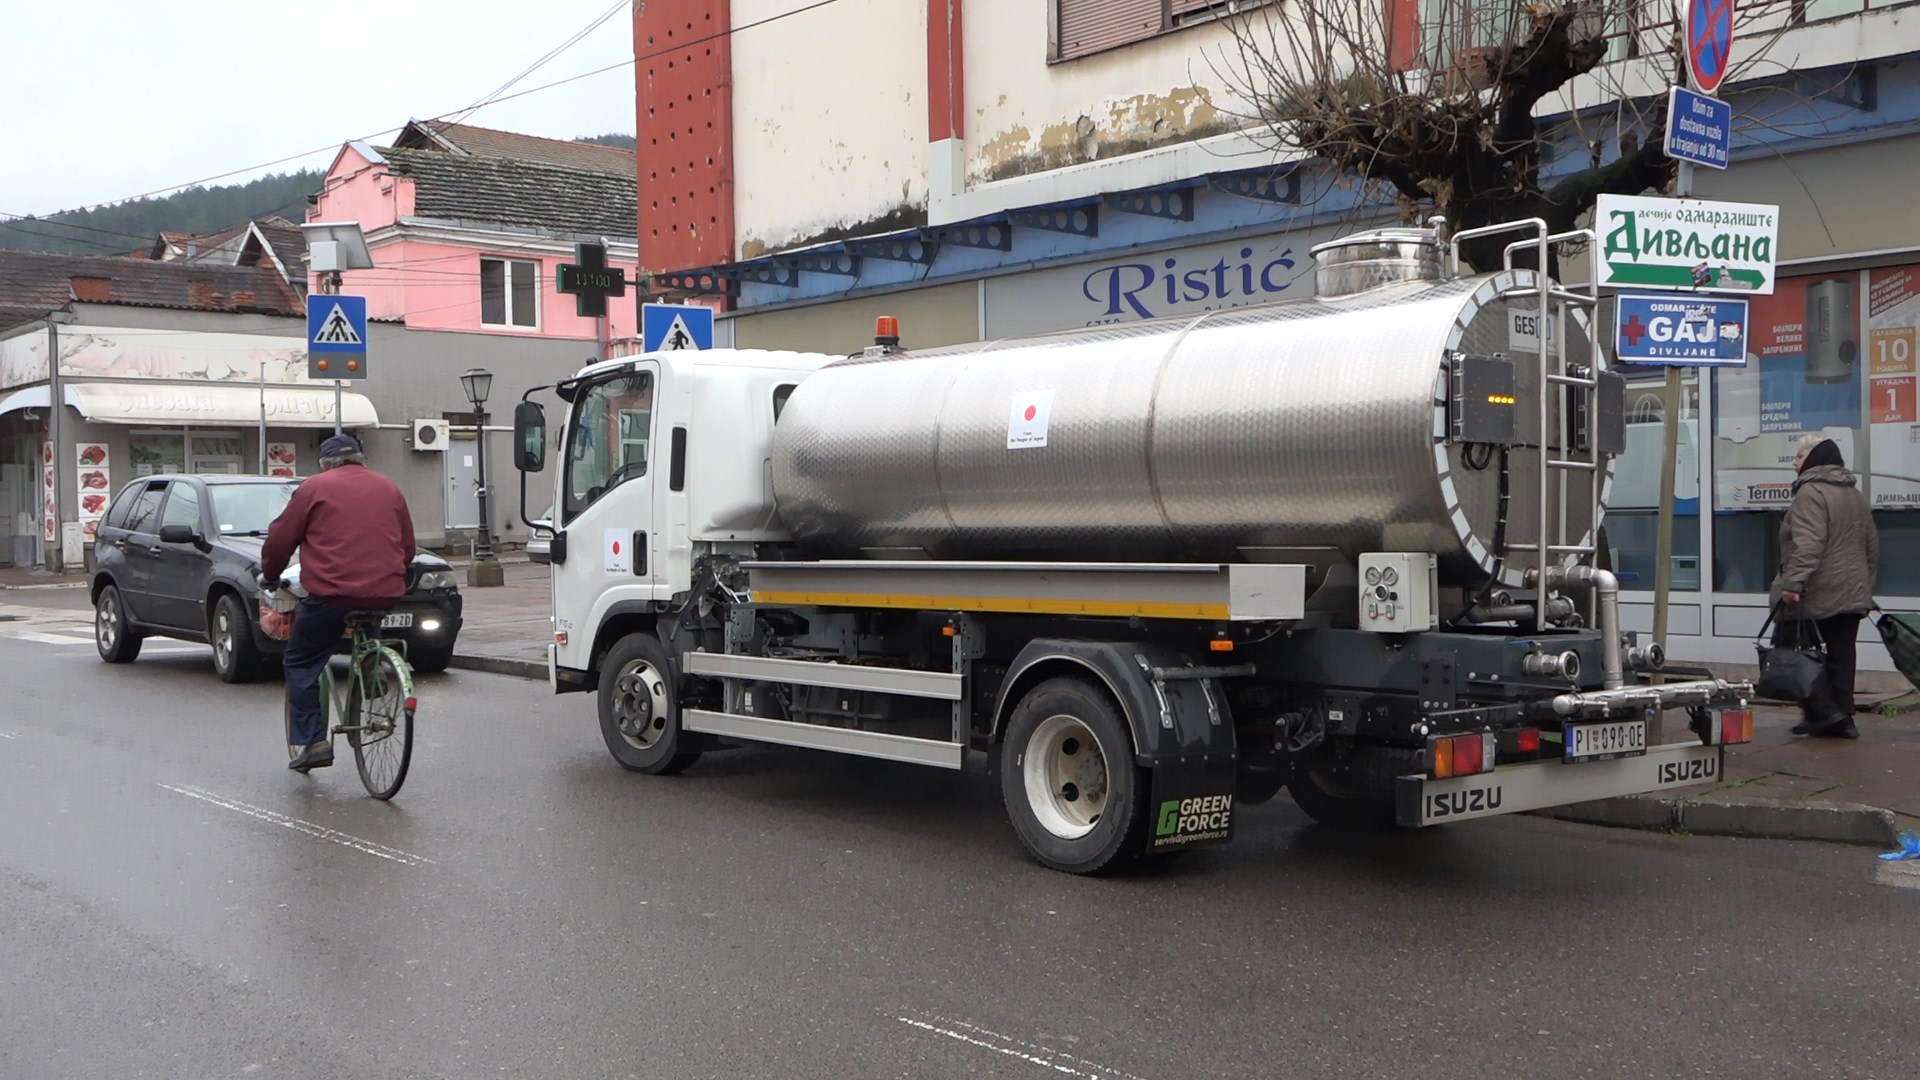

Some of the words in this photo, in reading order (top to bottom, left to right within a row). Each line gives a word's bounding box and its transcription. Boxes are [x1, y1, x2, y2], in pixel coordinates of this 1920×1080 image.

[1699, 143, 1707, 157] od
[1707, 143, 1716, 159] 30
[1676, 209, 1772, 229] одмаралиште
[1603, 209, 1771, 264] Дивљана
[576, 273, 611, 288] 11:00
[1082, 247, 1296, 319] Ristić
[1648, 316, 1715, 343] GAJ
[1649, 347, 1716, 357] DIVLJANE
[1877, 338, 1909, 362] 10
[1886, 388, 1897, 411] 1
[1576, 728, 1590, 753] PI
[1657, 757, 1715, 784] ISUZU
[1180, 794, 1232, 816] GREEN
[1426, 786, 1502, 818] ISUZU
[1176, 811, 1231, 833] FORCE
